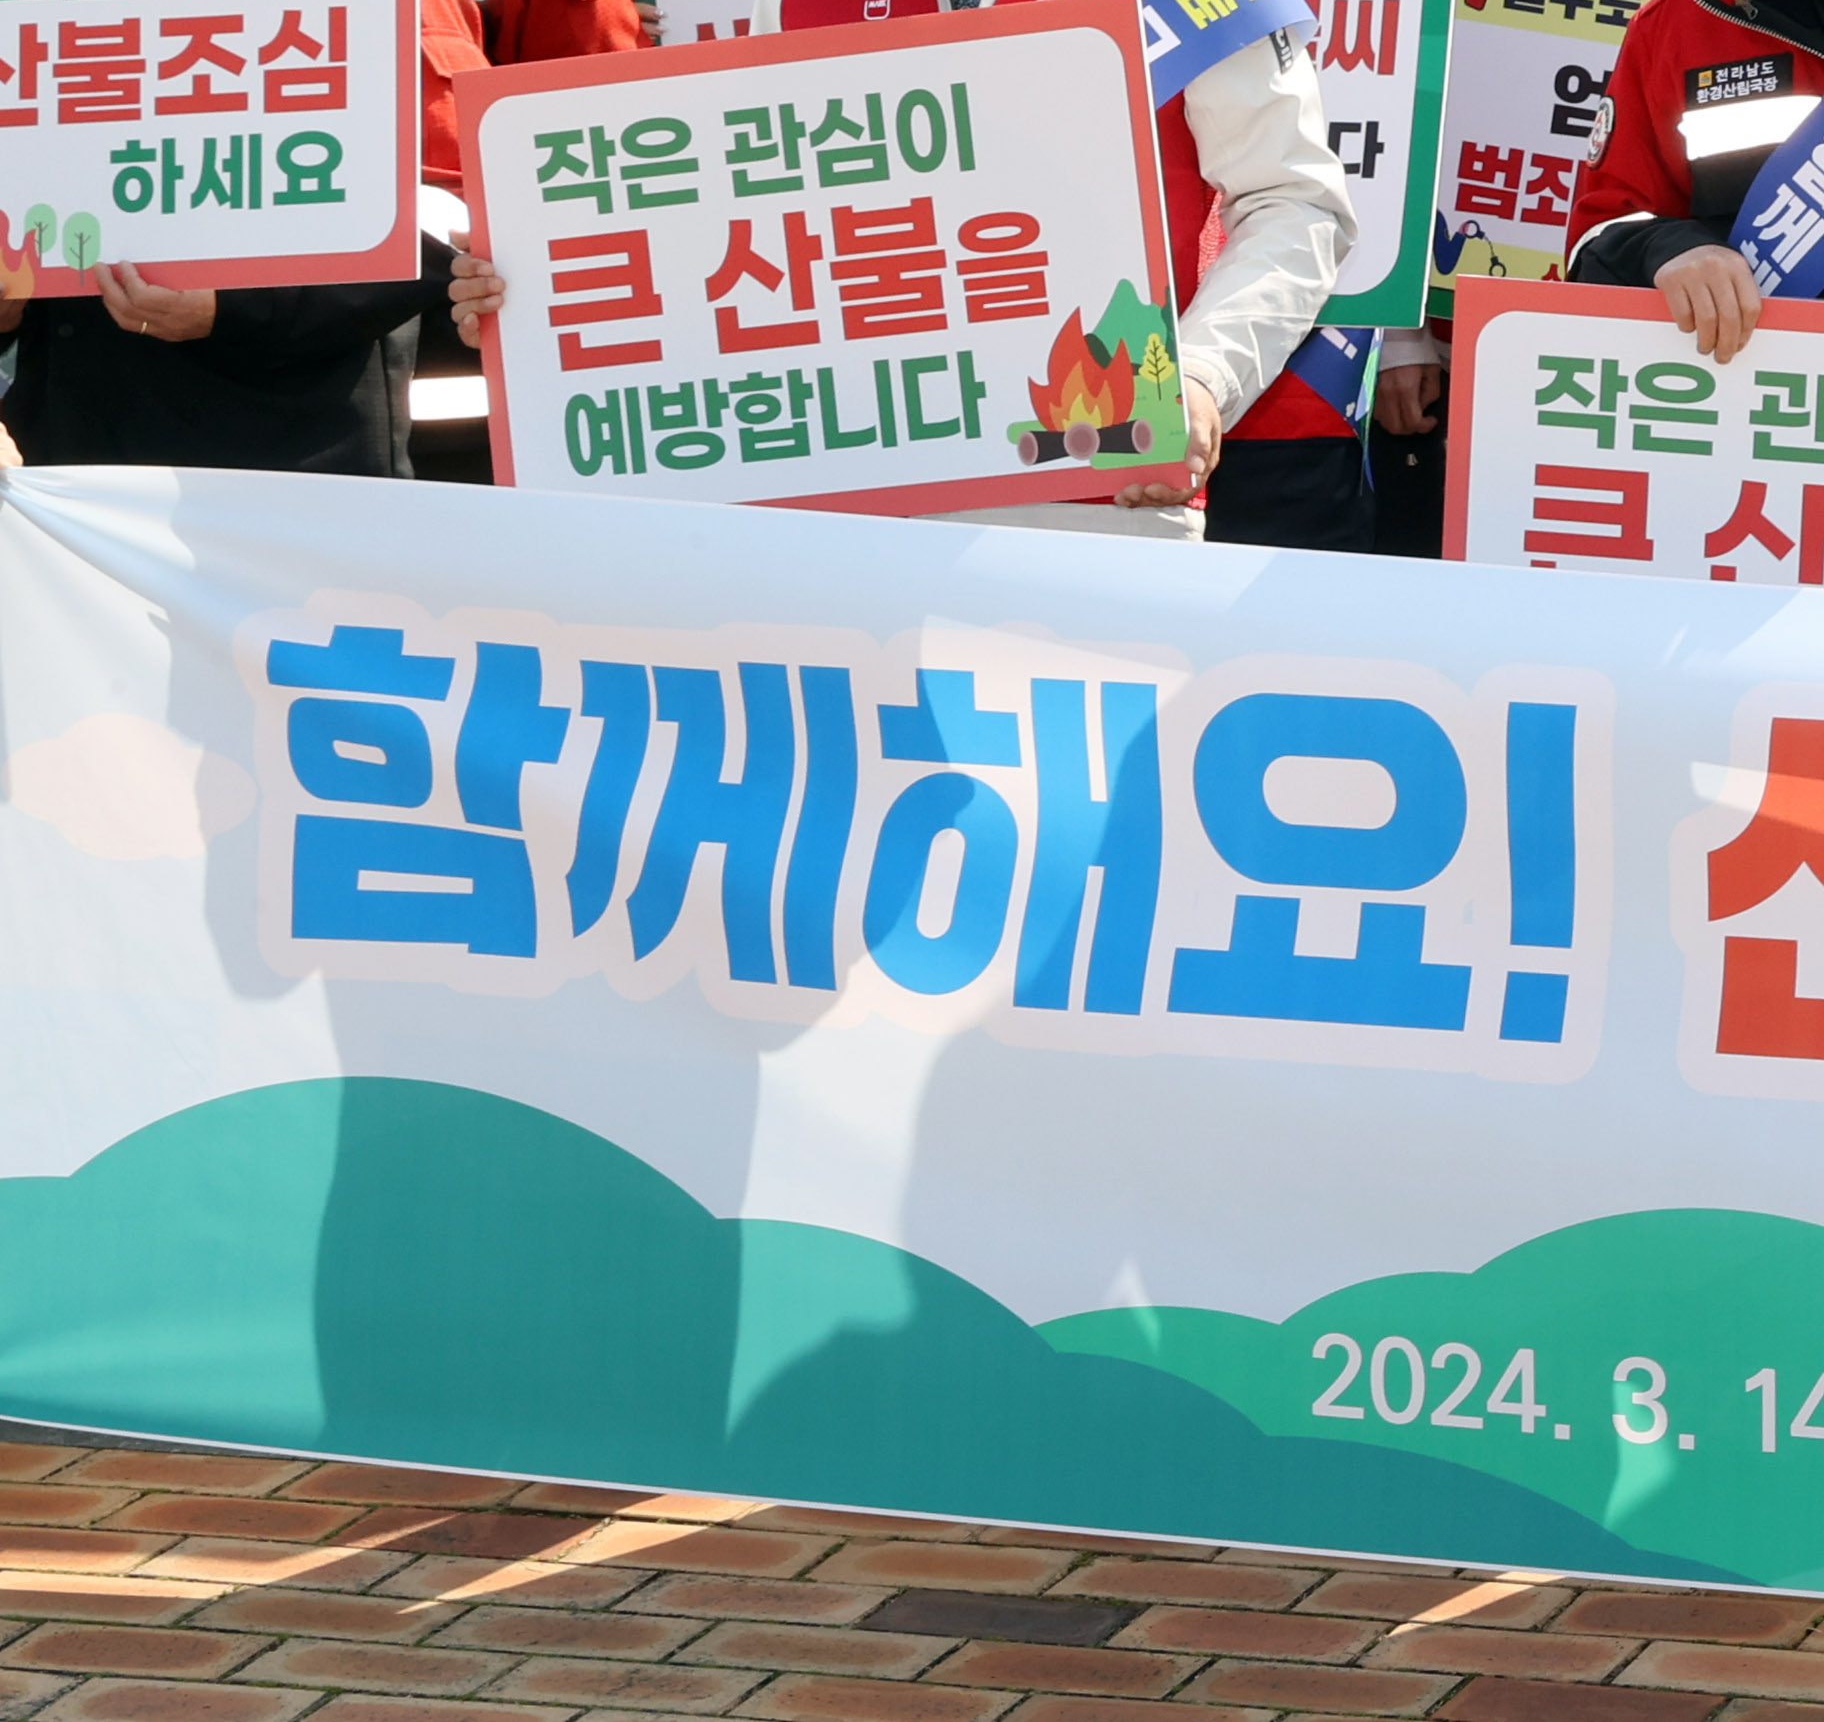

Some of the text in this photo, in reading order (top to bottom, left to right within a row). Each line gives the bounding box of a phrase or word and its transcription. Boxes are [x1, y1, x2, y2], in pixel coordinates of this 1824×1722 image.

[1696, 76, 1779, 103] 환경산림국장
[1715, 61, 1775, 82] 전라남도
[109, 130, 347, 215] 하세요
[533, 82, 977, 215] 작은 관심이
[546, 195, 1051, 373] 큰 산불을
[563, 349, 988, 479] 예방합니다
[1535, 354, 1719, 457] 작은
[266, 624, 1577, 1045] 함께해요!
[1311, 1331, 1572, 1441] 2024.
[1611, 1356, 1696, 1451] 3.
